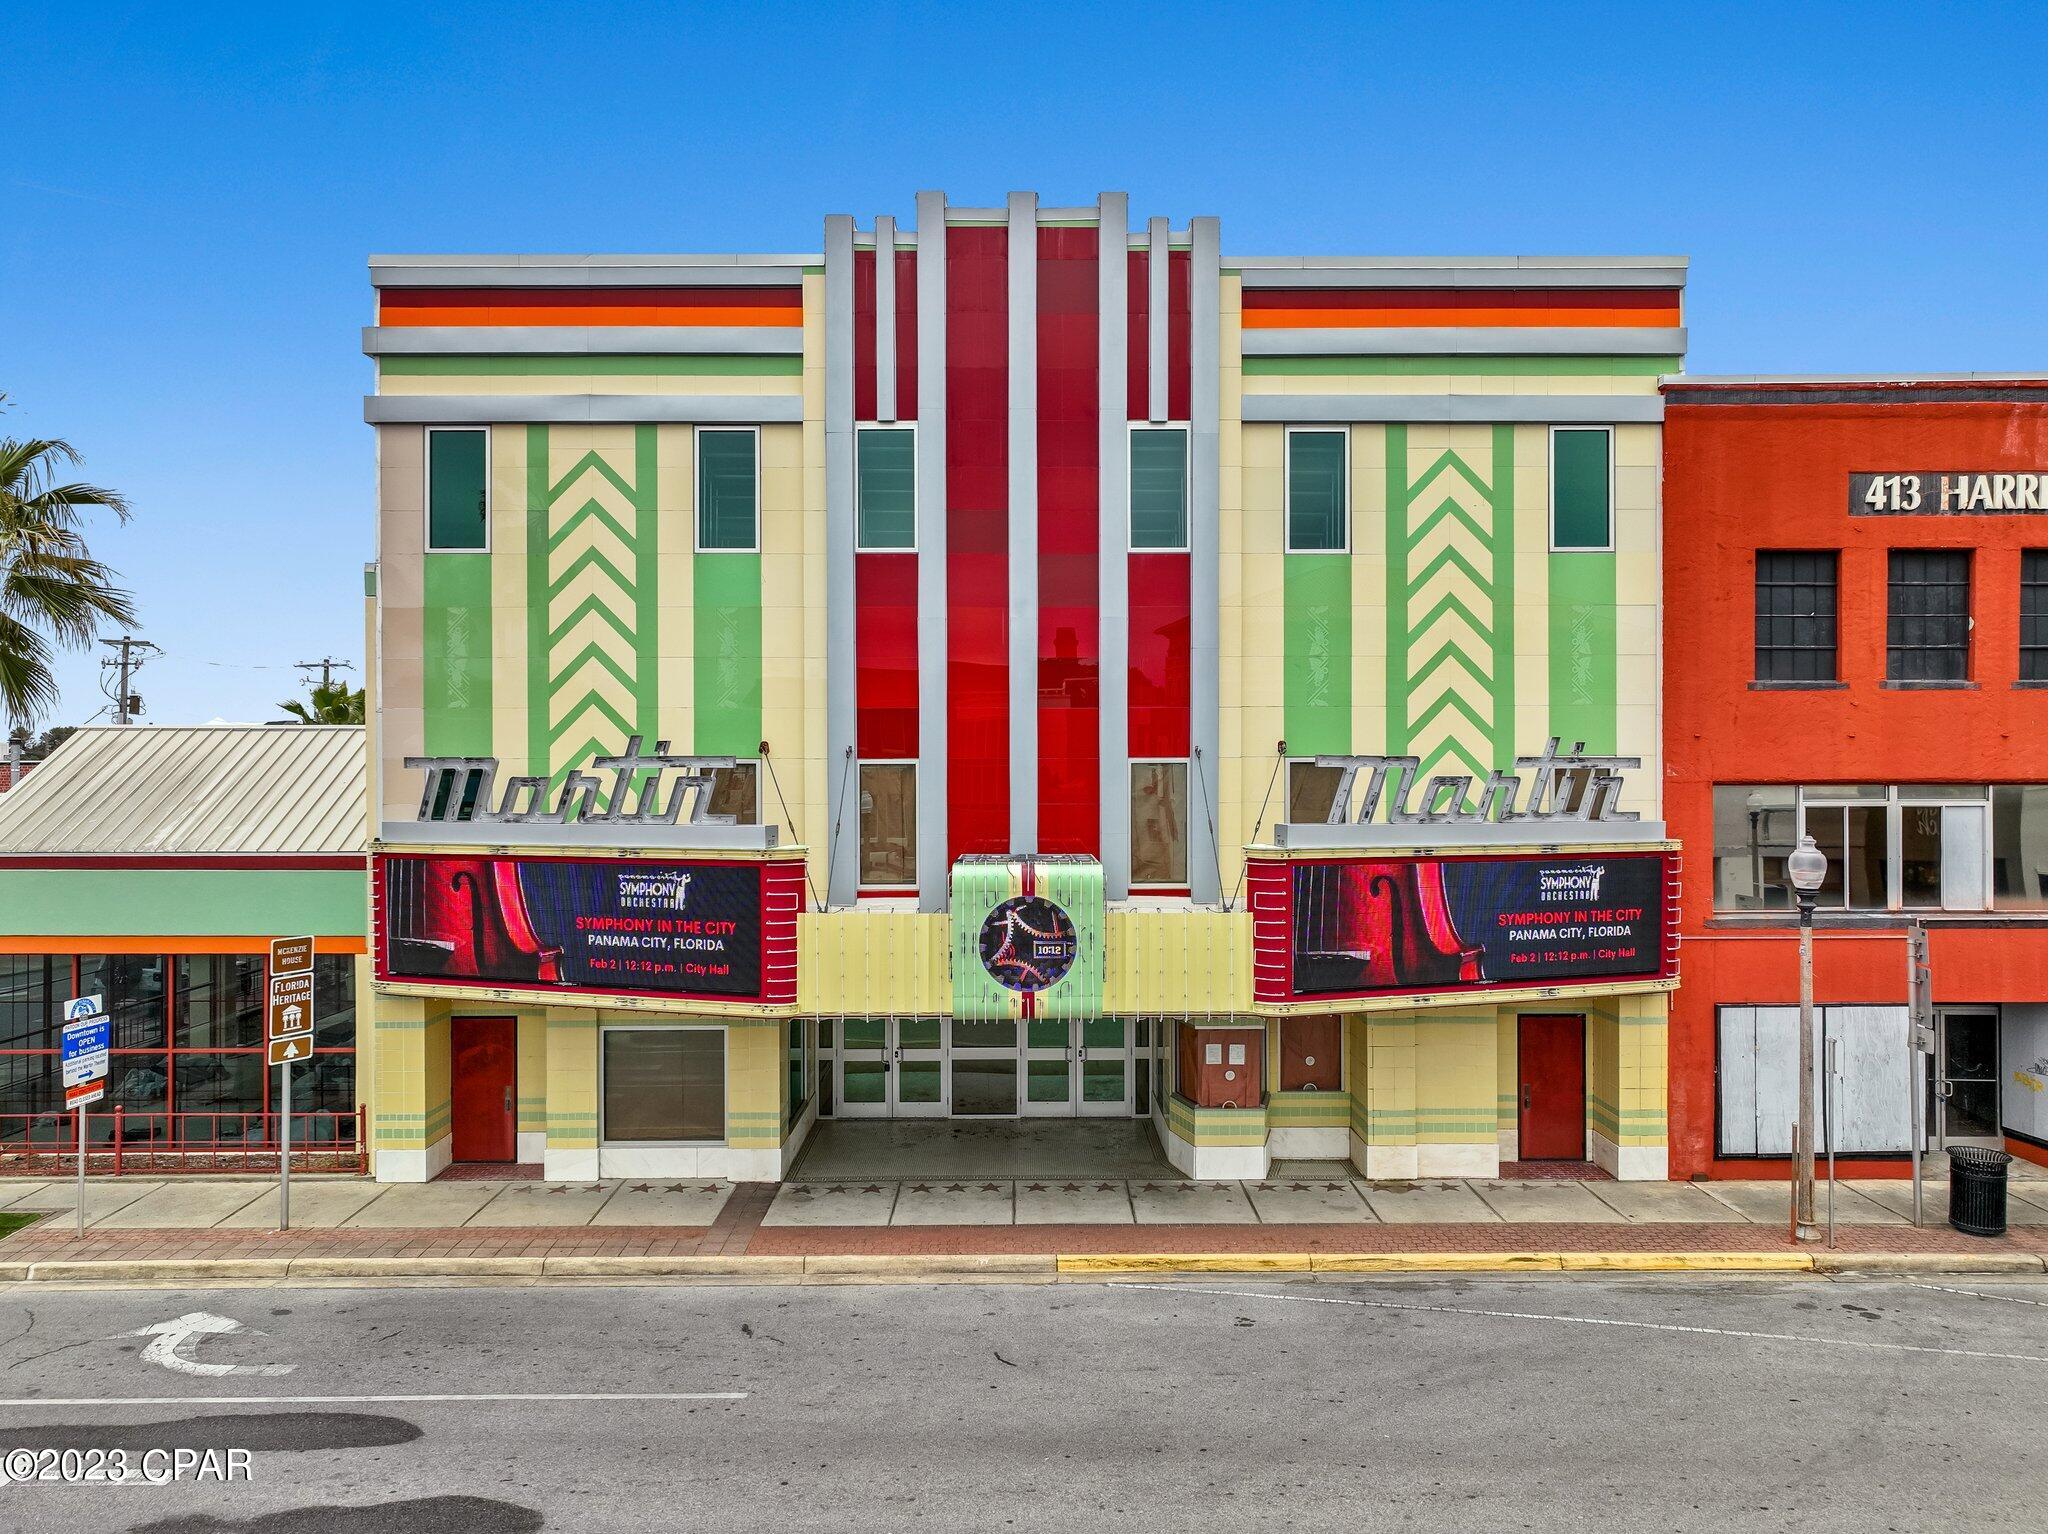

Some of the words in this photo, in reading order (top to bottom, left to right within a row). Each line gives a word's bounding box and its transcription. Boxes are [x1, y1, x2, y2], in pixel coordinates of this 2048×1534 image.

[1865, 475, 1922, 511] 413
[1940, 474, 2048, 511] HARRI
[404, 735, 737, 826] Martin
[1314, 736, 1642, 825] Martin
[620, 881, 676, 897] SYMPHONY
[1540, 876, 1591, 890] SYMPHONY
[620, 896, 675, 909] ORCHESTRA
[1541, 890, 1590, 901] ORCHESTRA
[576, 916, 653, 931] SYMPHONY
[657, 919, 672, 933] IN
[676, 920, 701, 934] THE
[705, 921, 737, 935] CITY
[1498, 912, 1571, 927] SYMPHONY
[1574, 910, 1588, 923] IN
[1591, 909, 1613, 922] THE
[1615, 908, 1643, 921] CITY
[1509, 928, 1557, 941] PANAMA
[1559, 926, 1586, 940] CITY,
[1588, 925, 1632, 938] FLORIDA
[277, 944, 308, 956] MCKENZIE
[588, 934, 639, 948] PANAMA
[641, 936, 672, 951] CITY,
[674, 937, 725, 951] FLORIDA
[281, 956, 303, 966] HOUSE
[1509, 952, 1527, 963] Feb
[1530, 952, 1536, 962] 2
[1543, 951, 1569, 962] 12:12
[1571, 952, 1591, 962] p.m.
[1598, 949, 1616, 960] City
[1619, 947, 1636, 957] Hall
[589, 958, 607, 969] Feb
[610, 959, 617, 969] 2
[625, 959, 652, 971] 12:12
[654, 962, 677, 974] p.m.
[685, 963, 707, 976] City
[709, 963, 730, 975] Hall
[274, 979, 310, 993] FLORIDA
[272, 990, 312, 1006] HERITAGE
[67, 1028, 98, 1041] Downtown
[99, 1025, 105, 1033] is
[78, 1036, 96, 1047] OPEN
[68, 1050, 77, 1059] for
[79, 1043, 105, 1055] business
